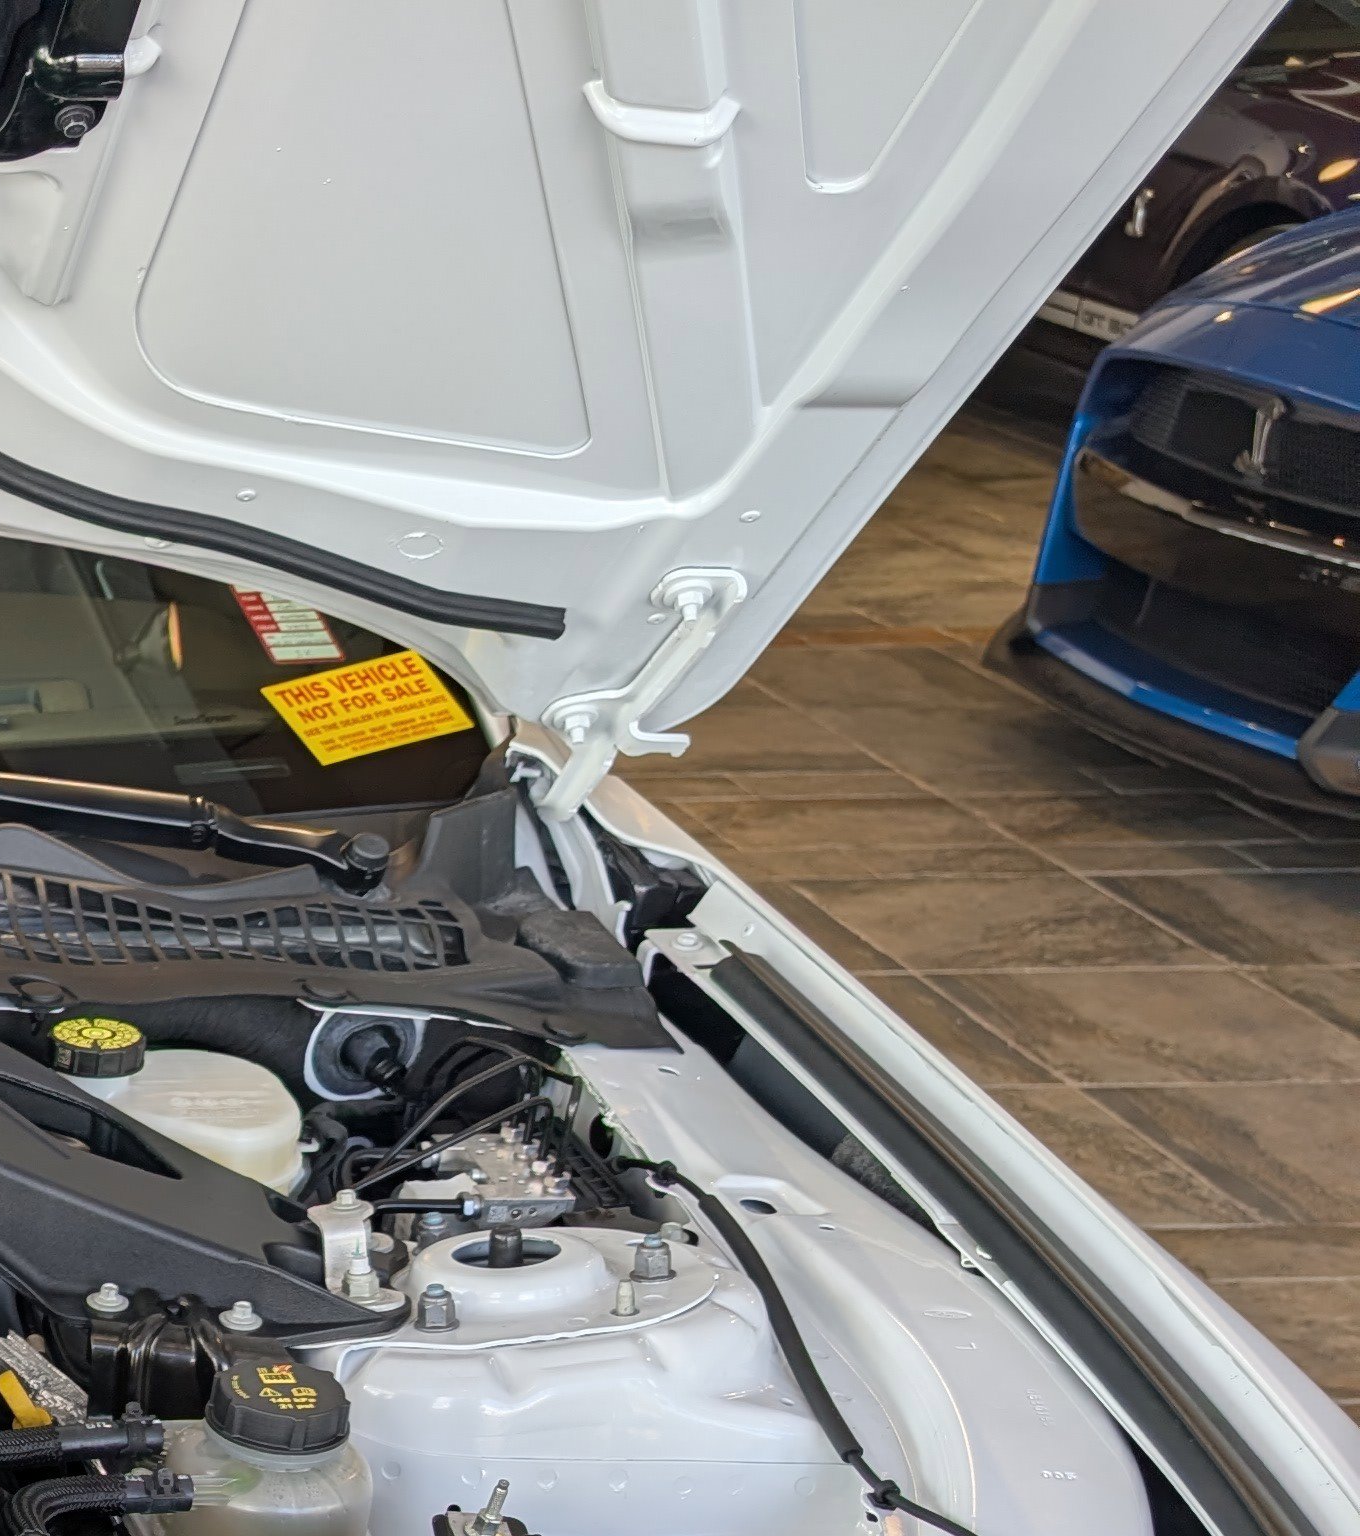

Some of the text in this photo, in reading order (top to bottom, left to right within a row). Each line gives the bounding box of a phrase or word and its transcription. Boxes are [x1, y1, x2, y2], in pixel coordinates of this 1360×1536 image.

[275, 657, 422, 707] THIS VEHICLE
[297, 678, 432, 724] NOT FOR SALE
